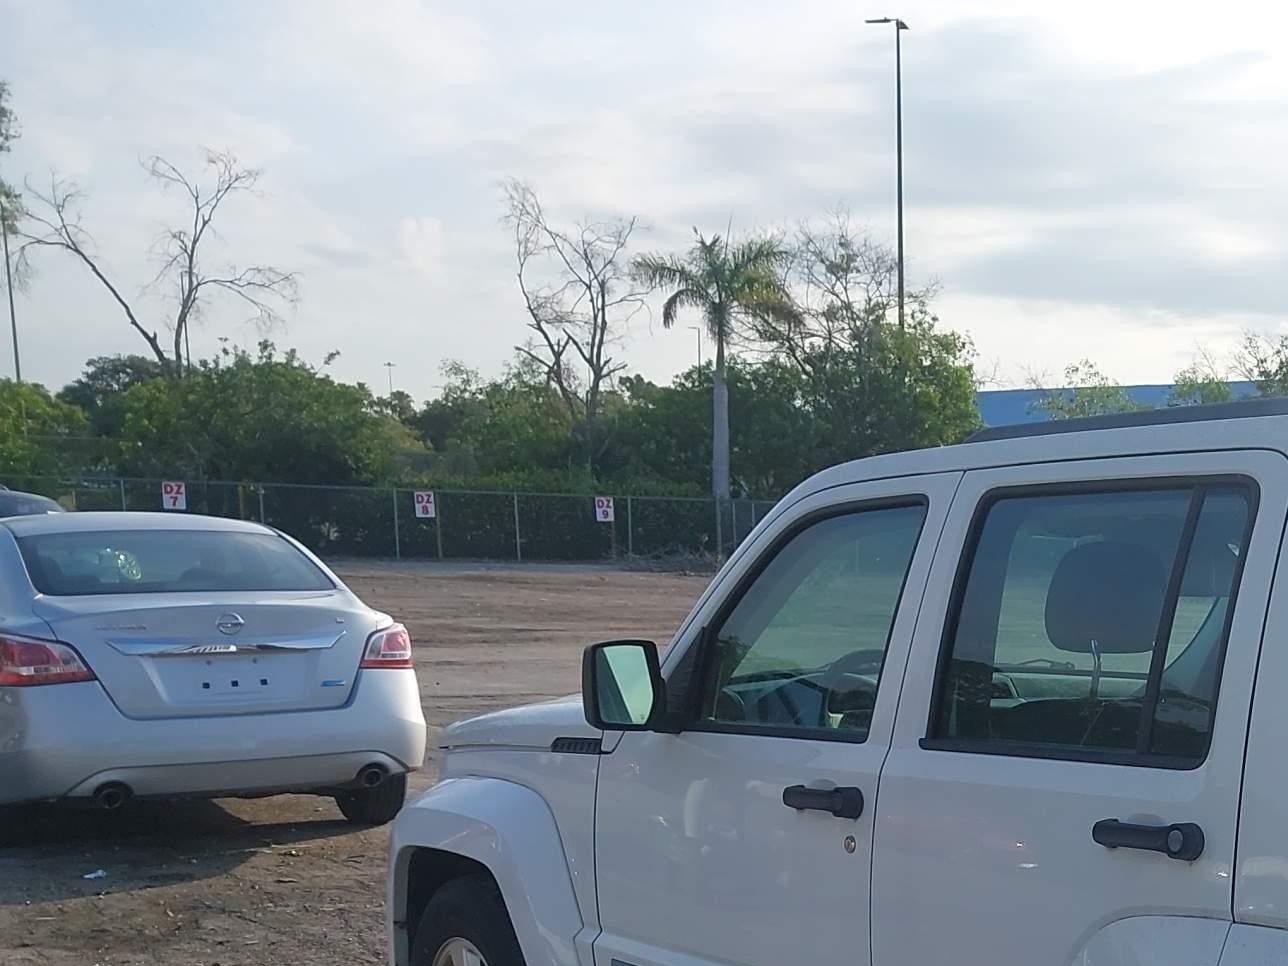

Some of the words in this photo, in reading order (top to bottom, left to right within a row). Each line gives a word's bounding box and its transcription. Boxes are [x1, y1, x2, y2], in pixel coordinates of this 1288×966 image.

[164, 483, 184, 495] DZ
[170, 496, 178, 507] 7
[416, 494, 432, 504] DZ
[597, 499, 612, 509] DZ
[422, 504, 429, 516] 8
[602, 510, 609, 519] 9
